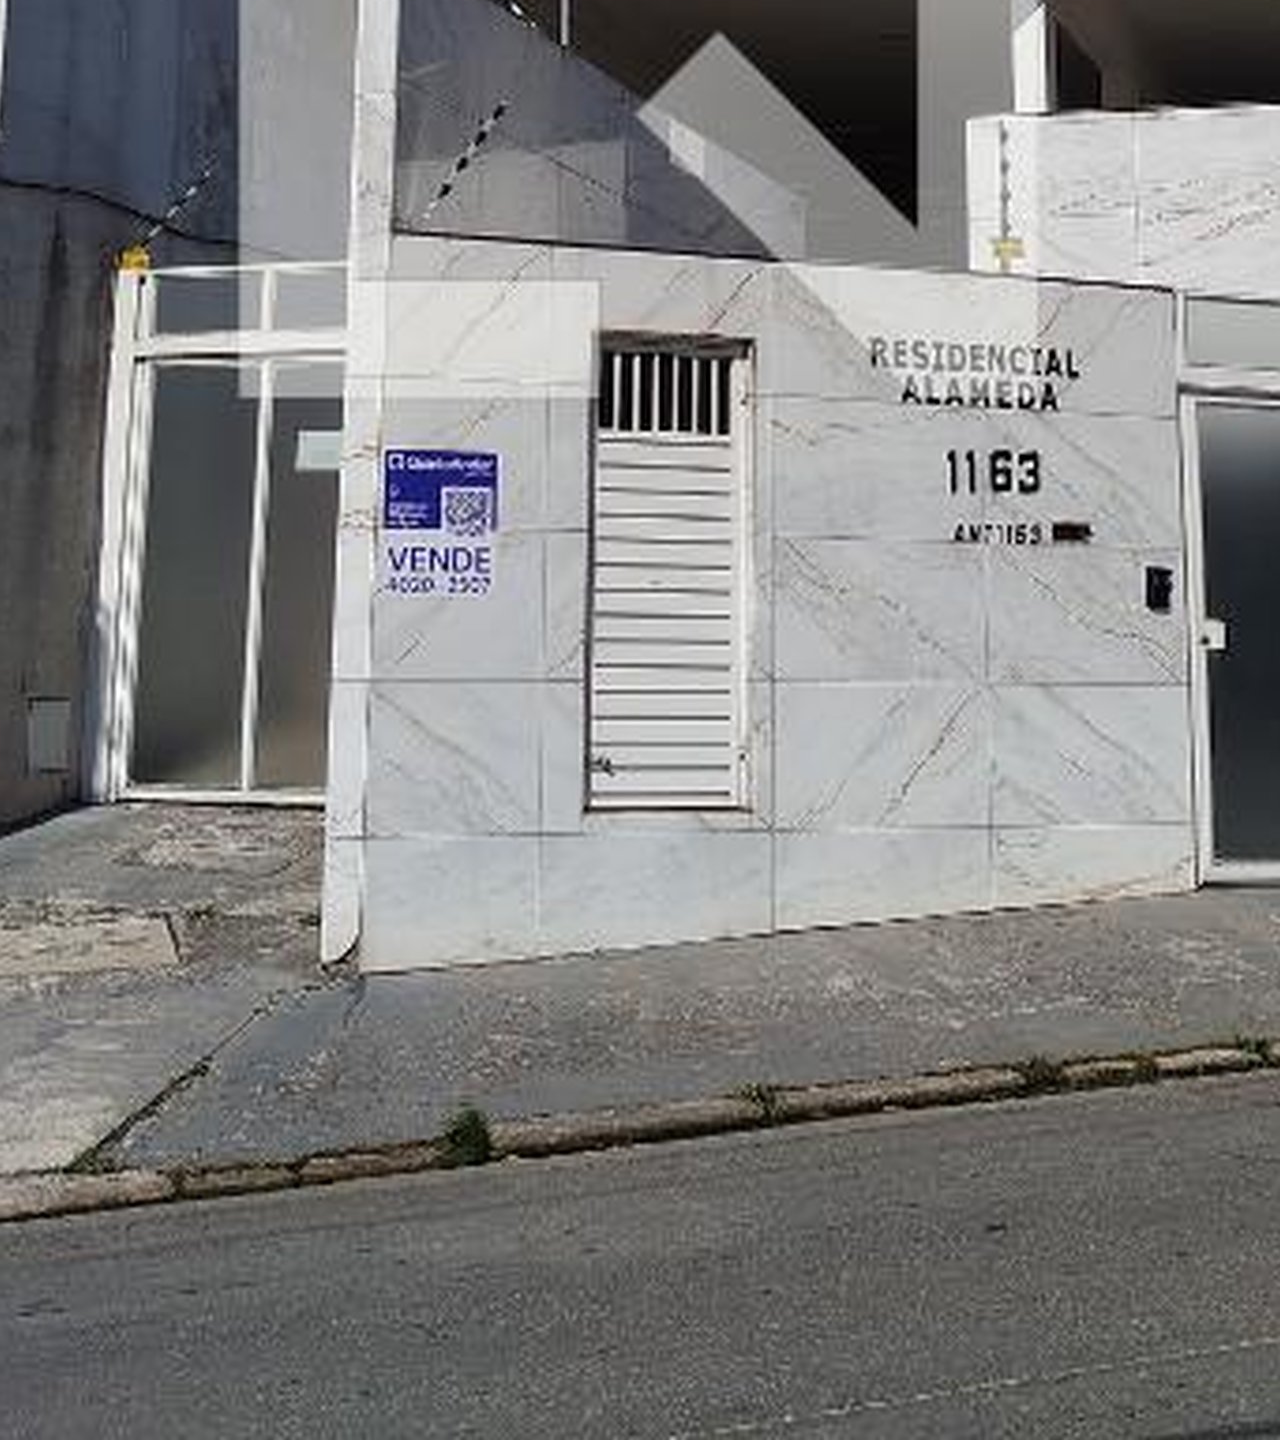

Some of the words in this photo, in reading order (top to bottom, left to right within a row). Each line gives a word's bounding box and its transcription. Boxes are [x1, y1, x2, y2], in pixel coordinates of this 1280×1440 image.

[871, 337, 1079, 379] RESIDENCIAL
[901, 375, 1060, 411] ALAMEDA
[946, 449, 1041, 494] 1163
[388, 546, 491, 574] VENDE
